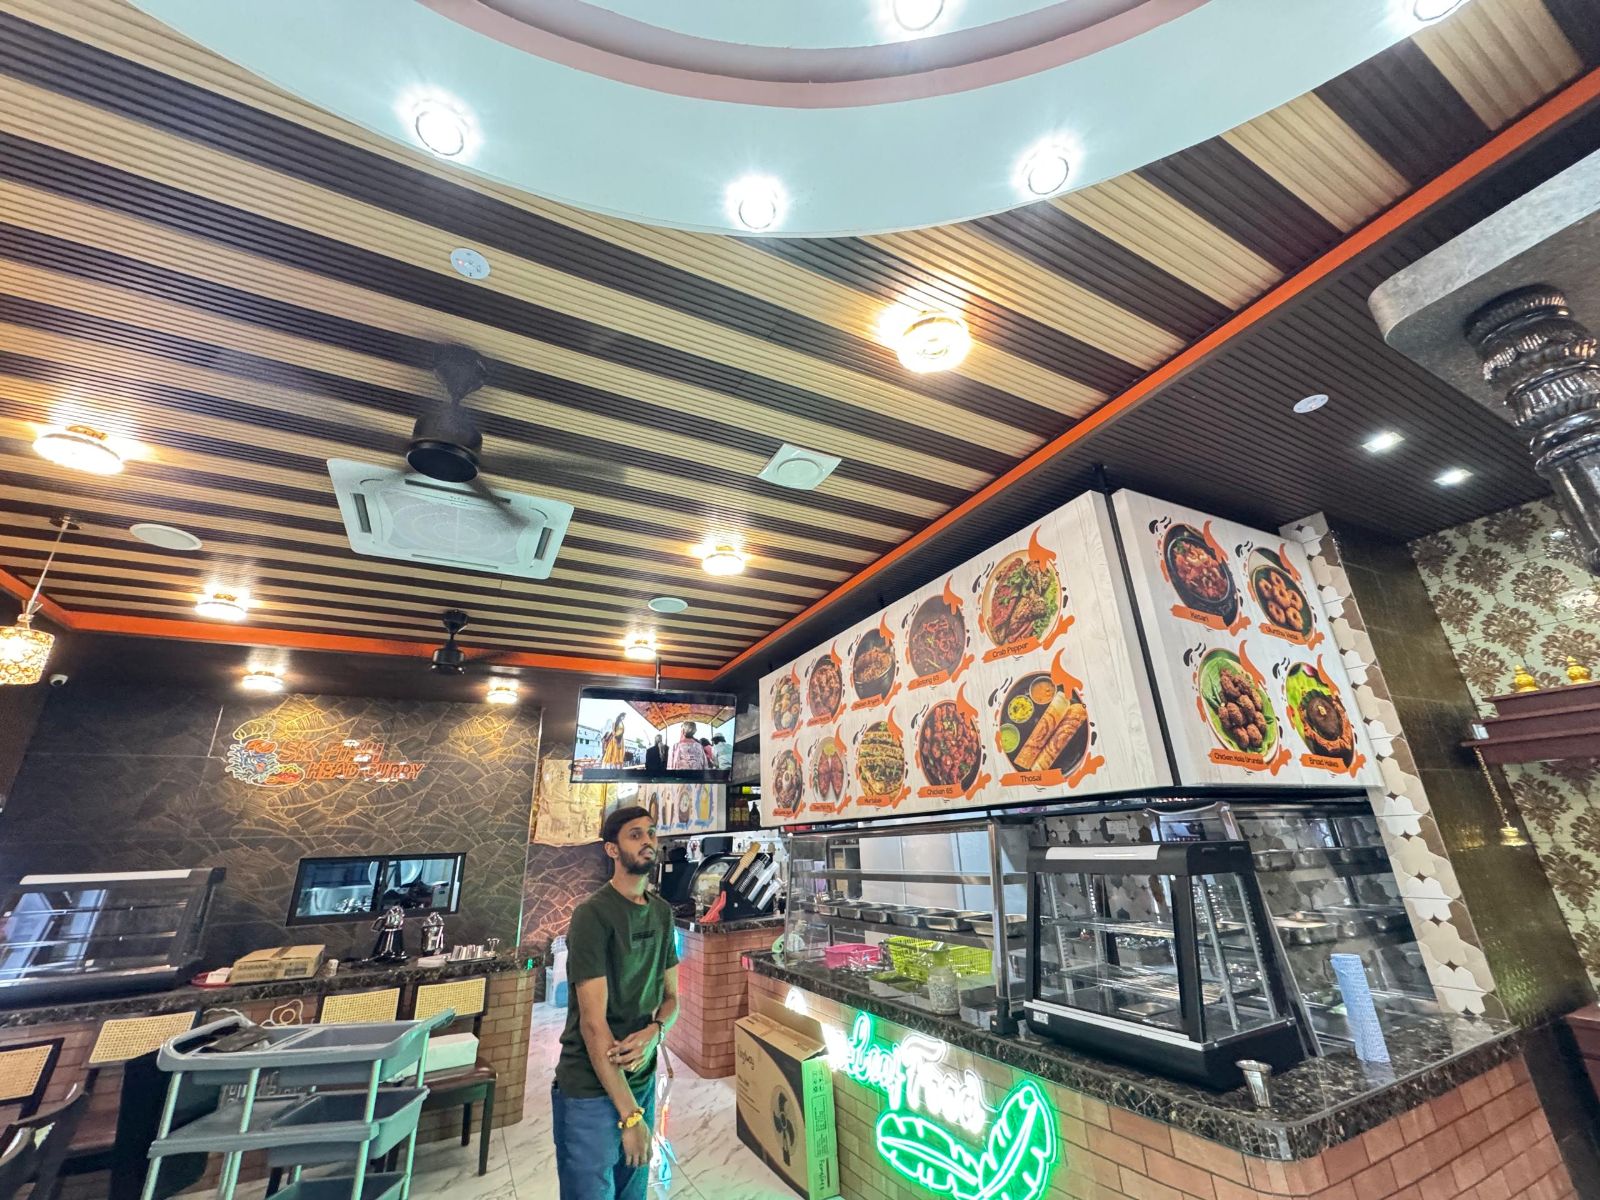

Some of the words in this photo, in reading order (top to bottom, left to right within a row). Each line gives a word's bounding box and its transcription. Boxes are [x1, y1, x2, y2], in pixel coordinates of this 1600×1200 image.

[992, 649, 1007, 658] Crab
[1007, 642, 1029, 654] Pepper
[279, 740, 320, 762] SK
[304, 760, 361, 779] HEAD
[362, 761, 426, 781] CURRY
[1020, 773, 1042, 783] Thosai
[926, 788, 945, 796] Chicken
[945, 786, 953, 794] 65
